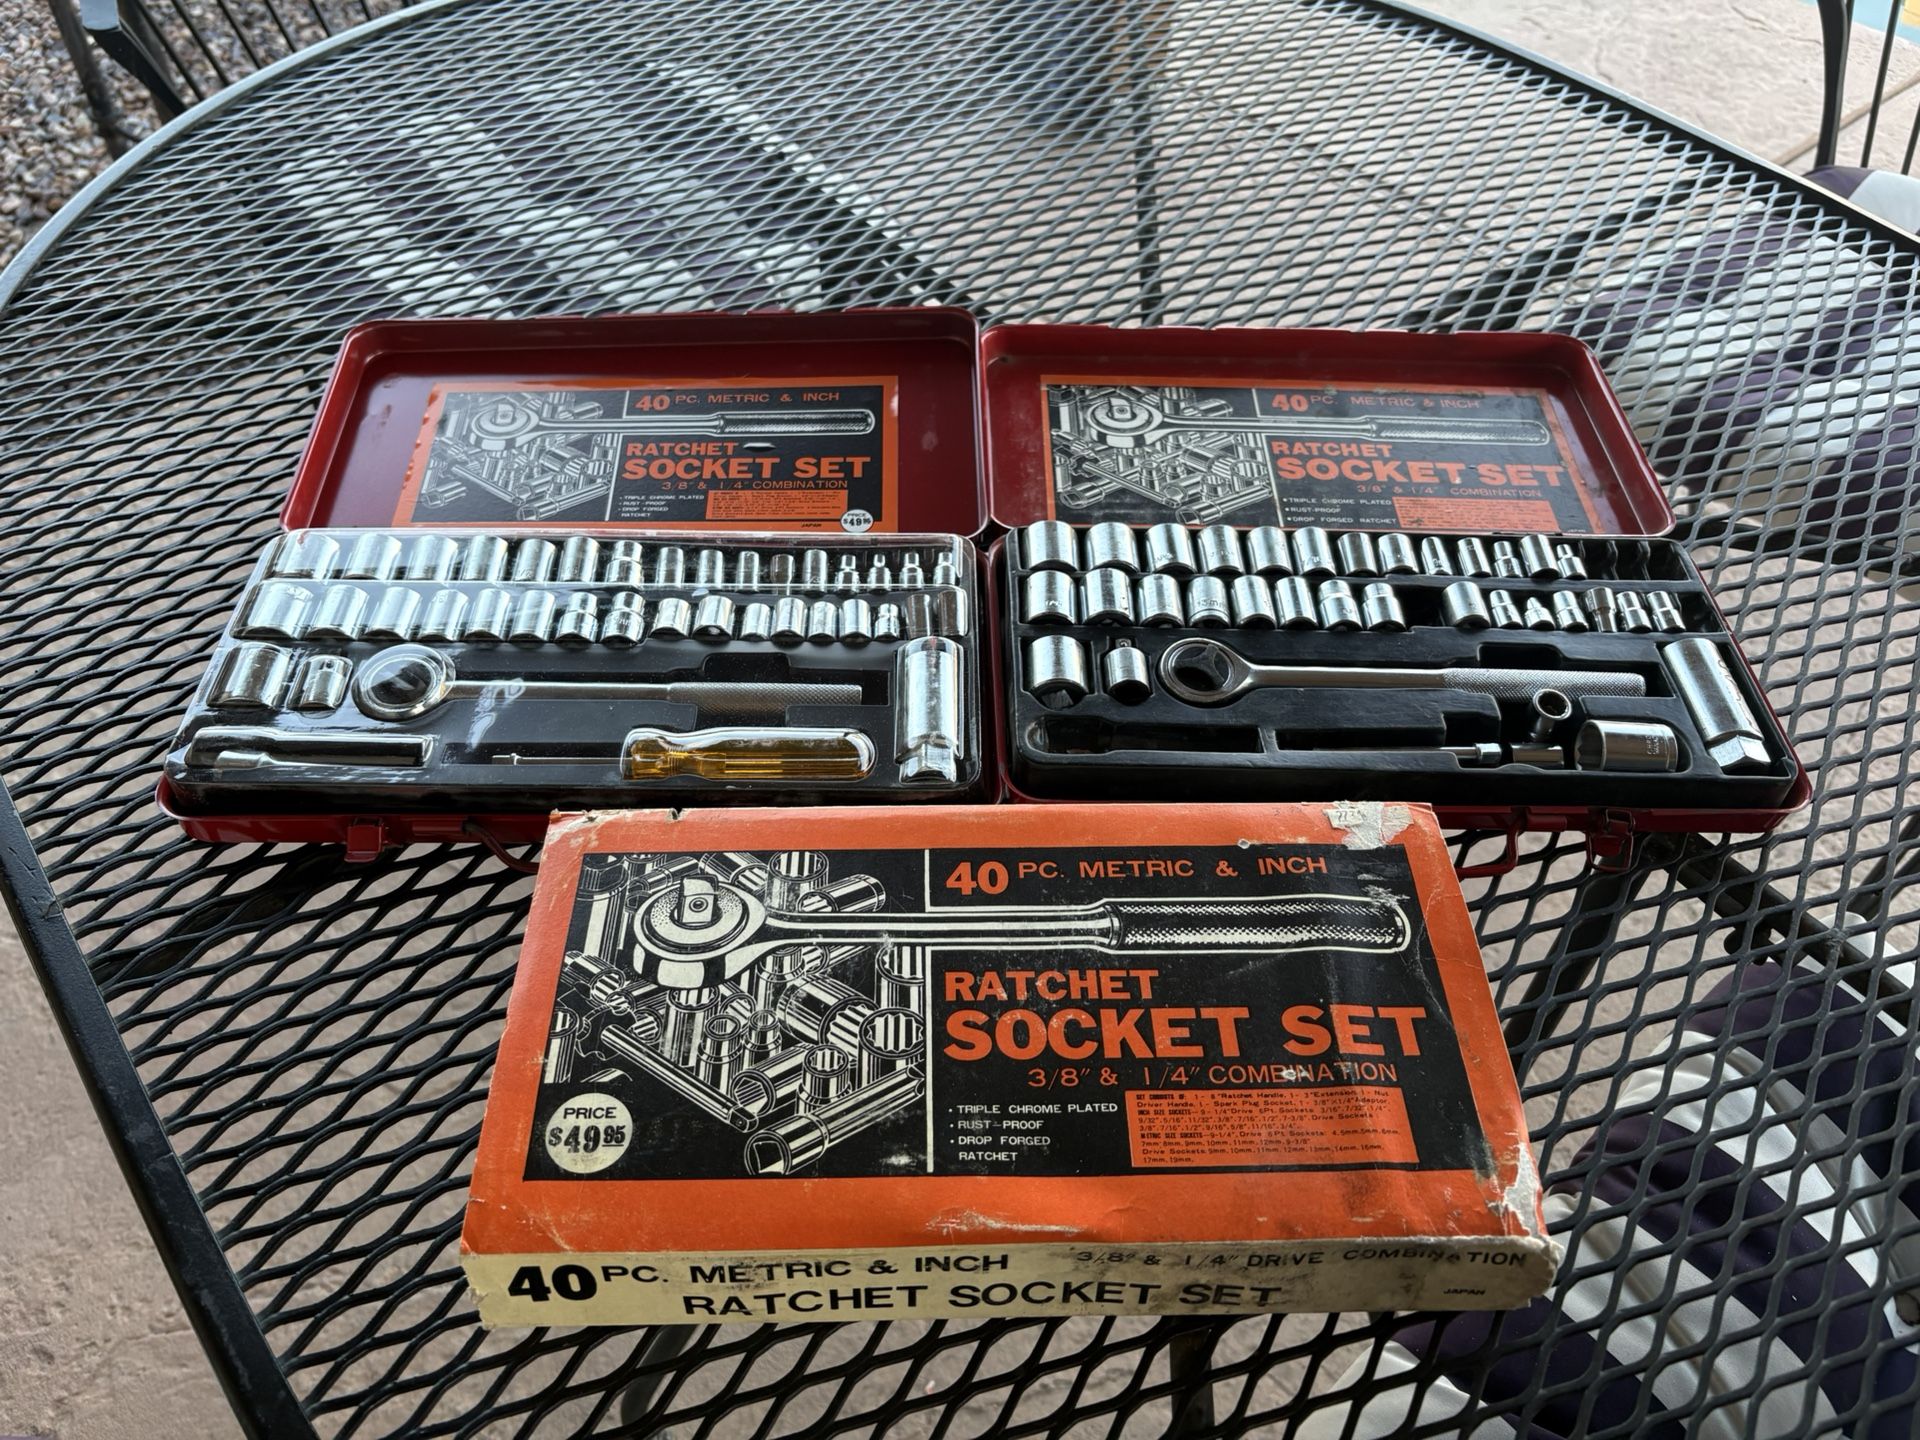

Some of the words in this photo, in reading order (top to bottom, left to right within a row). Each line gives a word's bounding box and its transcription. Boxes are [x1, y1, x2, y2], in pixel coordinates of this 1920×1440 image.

[635, 394, 670, 412] 40
[675, 394, 700, 404] PC.
[707, 392, 770, 404] METRIC
[780, 392, 793, 403] &
[803, 391, 840, 402] INCH
[1271, 393, 1309, 412] 40
[1309, 394, 1338, 405] PC.
[1350, 395, 1416, 408] METRIC
[1423, 398, 1434, 408] &
[1440, 398, 1481, 409] INCH
[626, 442, 739, 456] RATCHET
[1271, 441, 1393, 458] RATCHET
[620, 457, 780, 481] SOCKET
[792, 456, 871, 479] SET
[1276, 457, 1467, 485] SOCKET
[1474, 462, 1564, 487] SET
[661, 480, 695, 491] 3/8"
[697, 481, 707, 490] &
[719, 480, 750, 490] 1/4"
[752, 479, 849, 489] COMBINATION
[1357, 484, 1386, 494] 3/8"
[1392, 485, 1402, 494] &
[1450, 486, 1542, 498] COMBINATION
[1359, 517, 1397, 525] RATCHET
[945, 860, 1009, 895] 40
[1018, 859, 1065, 880] PC.
[1078, 858, 1195, 879] METRIC
[1215, 859, 1238, 876] &
[1258, 856, 1328, 875] INCH
[944, 969, 1159, 1001] RATCHET
[943, 1006, 1250, 1060] SOCKET
[1281, 1003, 1427, 1057] SET
[1027, 1067, 1090, 1089] 3/8"
[1100, 1068, 1119, 1085] &
[956, 1105, 1001, 1114] TRIPLE
[1008, 1104, 1062, 1113] CHROME
[1067, 1103, 1118, 1113] PLATED
[1213, 1100, 1238, 1108] Spark
[563, 1107, 617, 1120] PRICE
[958, 1136, 992, 1145] DROP
[1000, 1136, 1051, 1145] FORGED
[958, 1151, 1018, 1161] RATCHET
[1143, 1254, 1163, 1266] &
[1247, 1251, 1324, 1268] DRIVE
[1343, 1248, 1528, 1267] COMBINATION
[507, 1263, 598, 1303] 40
[602, 1264, 669, 1284] PC.
[690, 1258, 852, 1284] METRIC
[866, 1258, 899, 1275] &
[914, 1253, 1009, 1273] INCH
[682, 1284, 928, 1316] RATCHET
[948, 1281, 1163, 1309] SOCKET
[1179, 1283, 1282, 1308] SET
[1442, 1287, 1487, 1297] JAPAN
